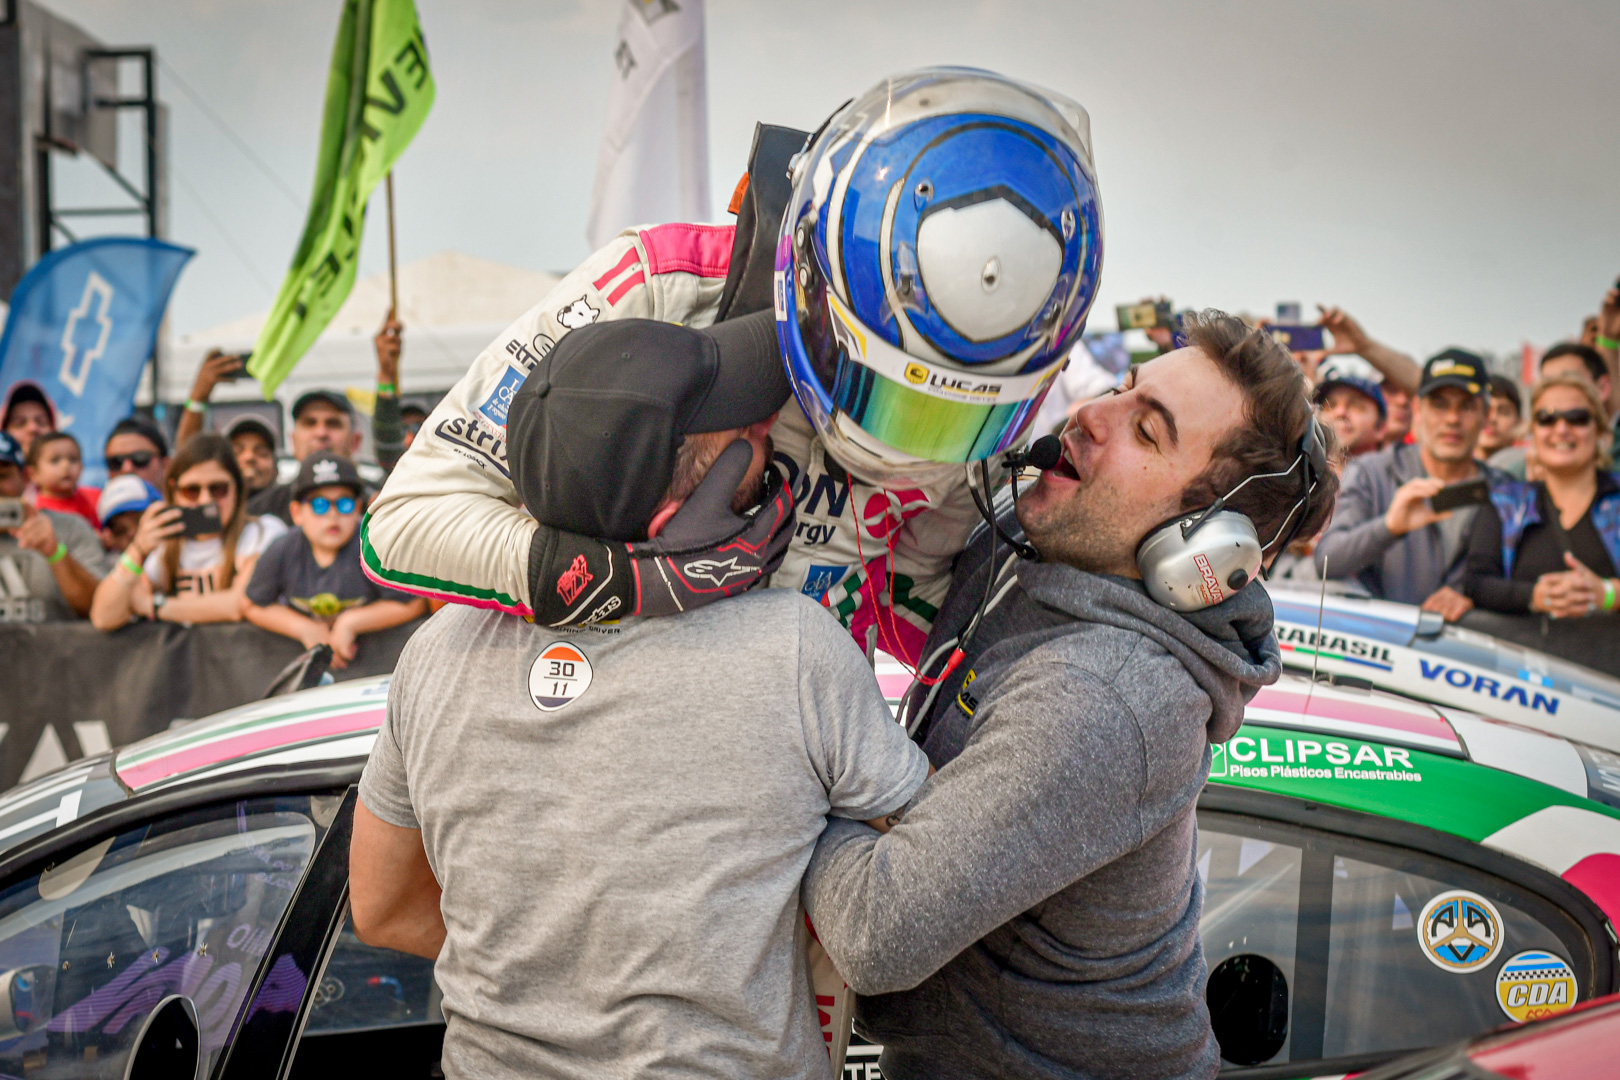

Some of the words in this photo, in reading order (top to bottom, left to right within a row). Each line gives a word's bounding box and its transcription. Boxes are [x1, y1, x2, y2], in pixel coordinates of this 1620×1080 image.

[930, 373, 1002, 393] LUCAS
[1193, 553, 1225, 605] BRAVA
[549, 660, 575, 677] 30
[552, 681, 568, 696] 11
[1419, 658, 1560, 716] VORAN
[1229, 736, 1414, 768] CLIPSAR
[1230, 763, 1268, 778] Pisos
[1270, 765, 1332, 779] Plásticos
[1334, 766, 1422, 782] Encastrables
[1507, 981, 1568, 1008] CDA
